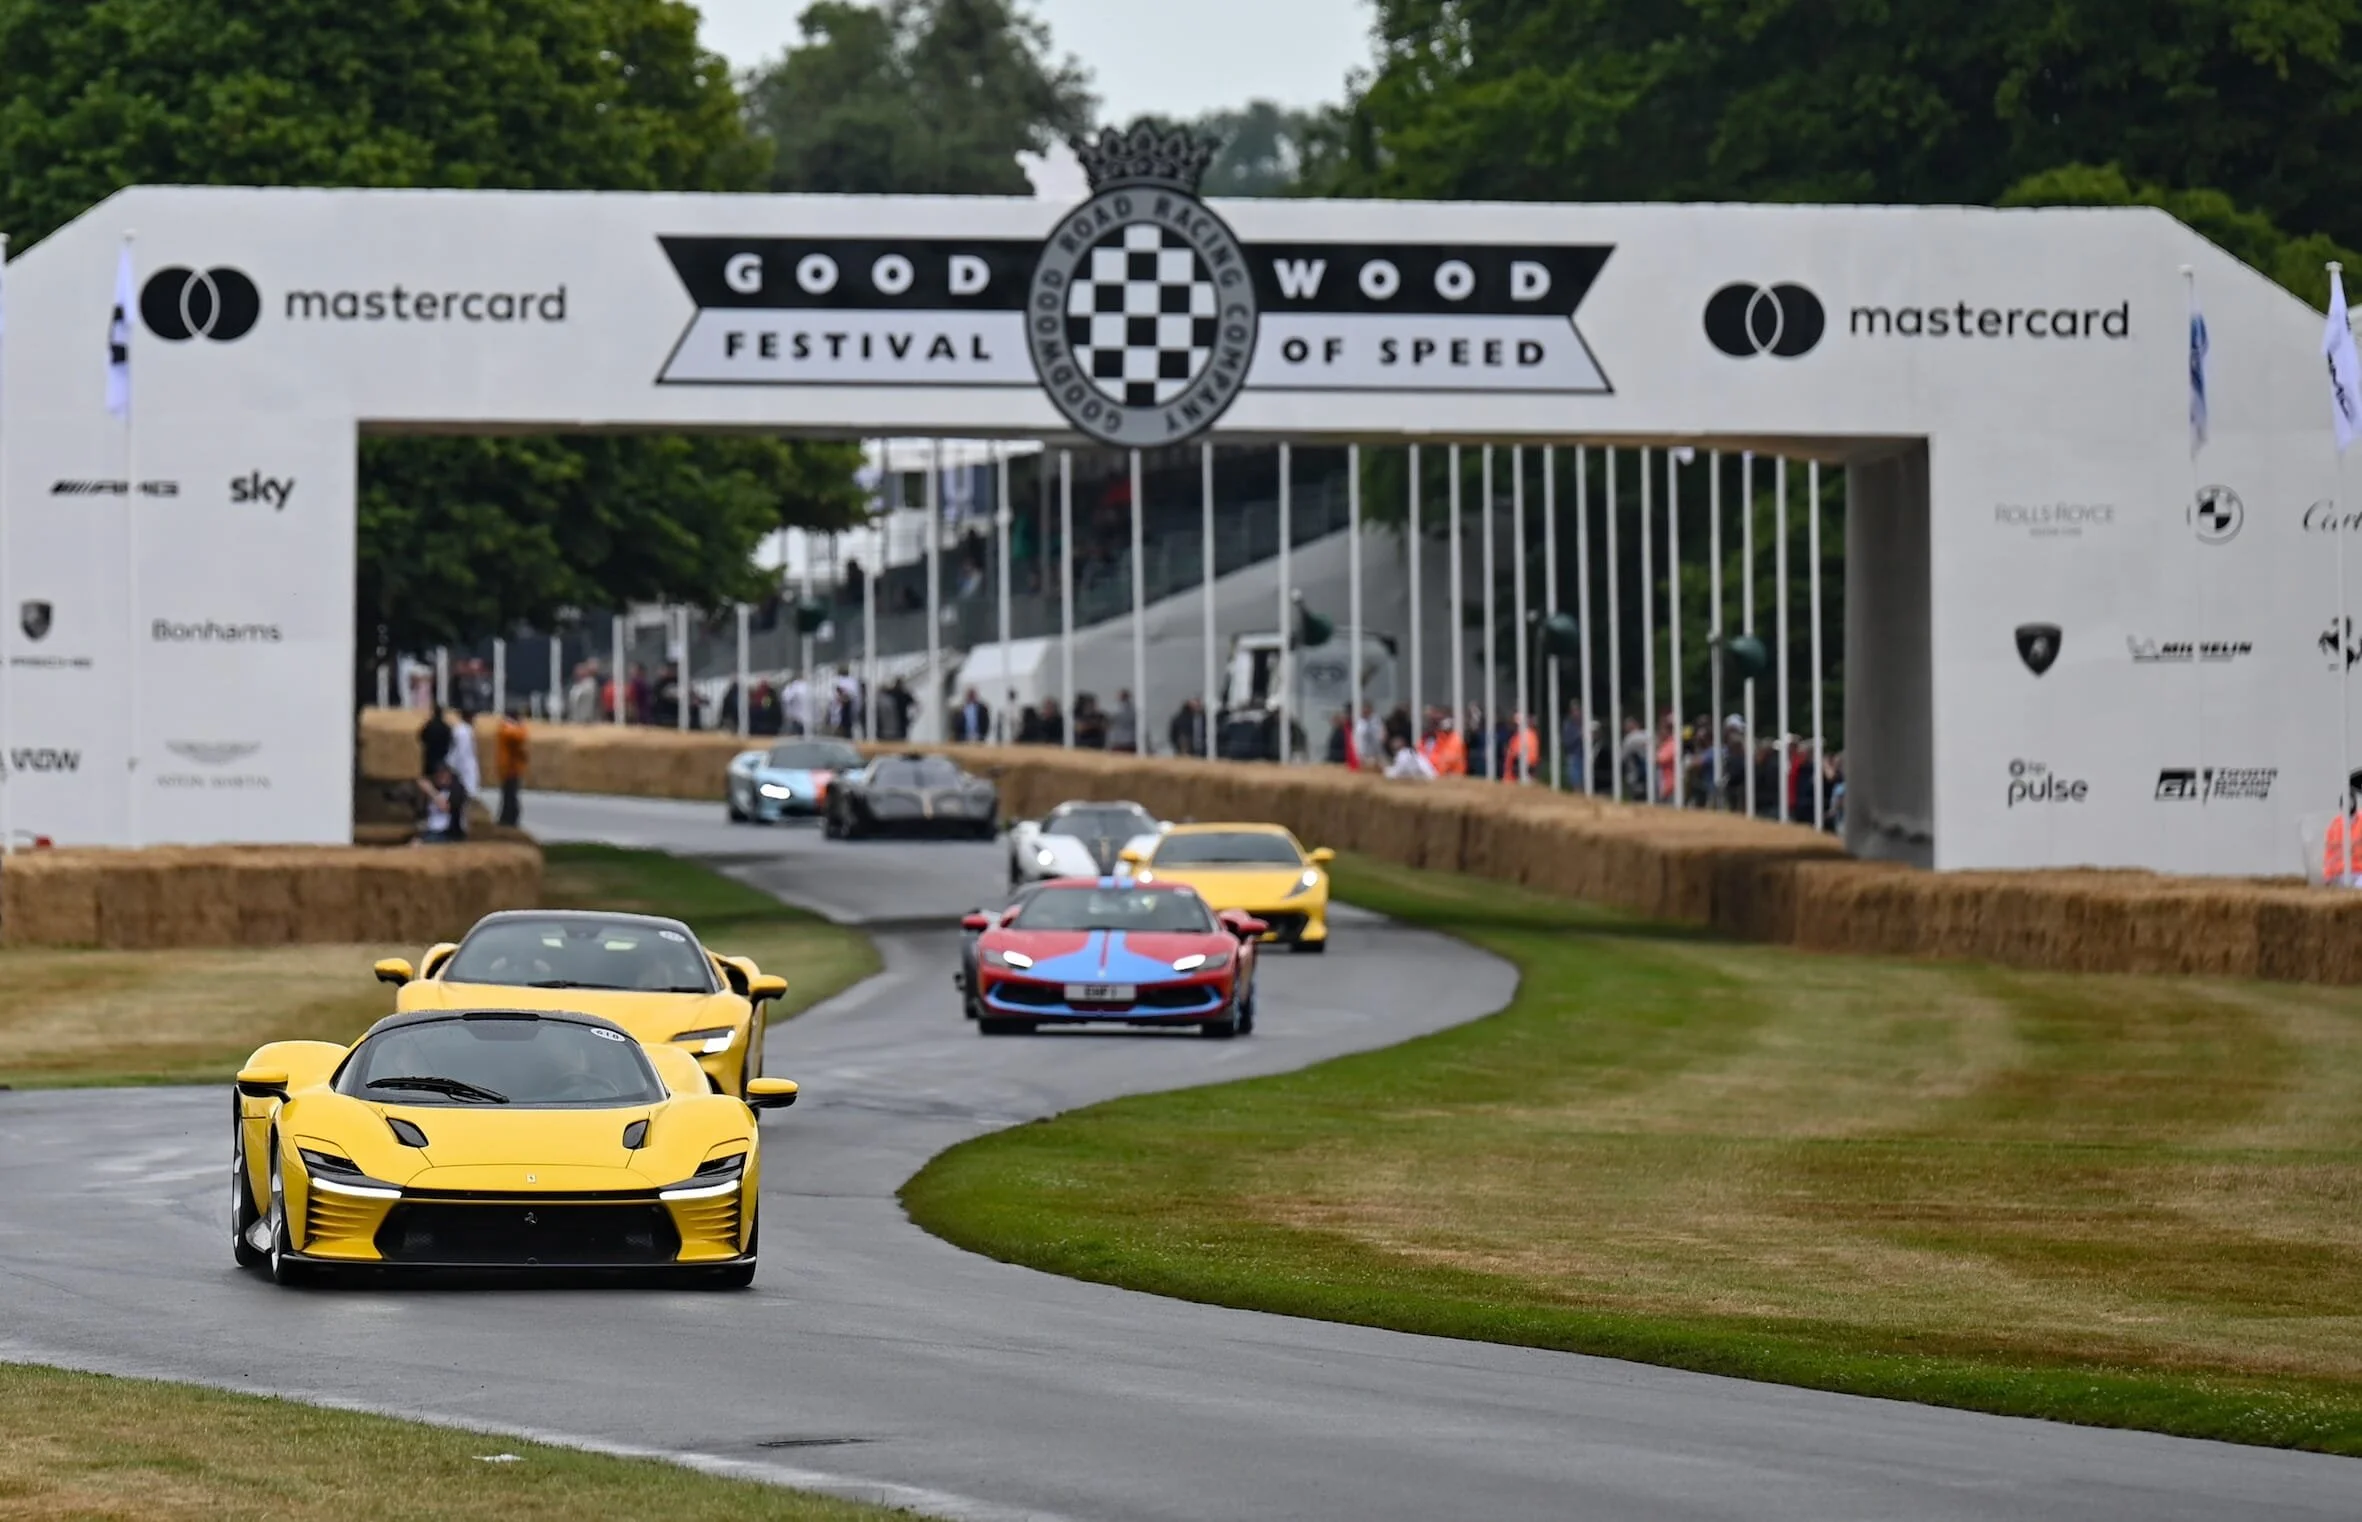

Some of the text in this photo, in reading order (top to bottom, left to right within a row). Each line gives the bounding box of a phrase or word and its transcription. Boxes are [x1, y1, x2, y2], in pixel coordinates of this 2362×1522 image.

[724, 252, 1552, 301] GOOD WOOD
[285, 284, 567, 322] mastercard
[1035, 194, 1249, 434] GOODWOOD ROAD RACING COMPANY
[1849, 300, 2130, 339] mastercard
[724, 331, 1546, 367] FESTIVAL OF SPEED
[230, 468, 296, 511] sky
[152, 618, 283, 643] Bonhams
[2007, 770, 2089, 809] pulse
